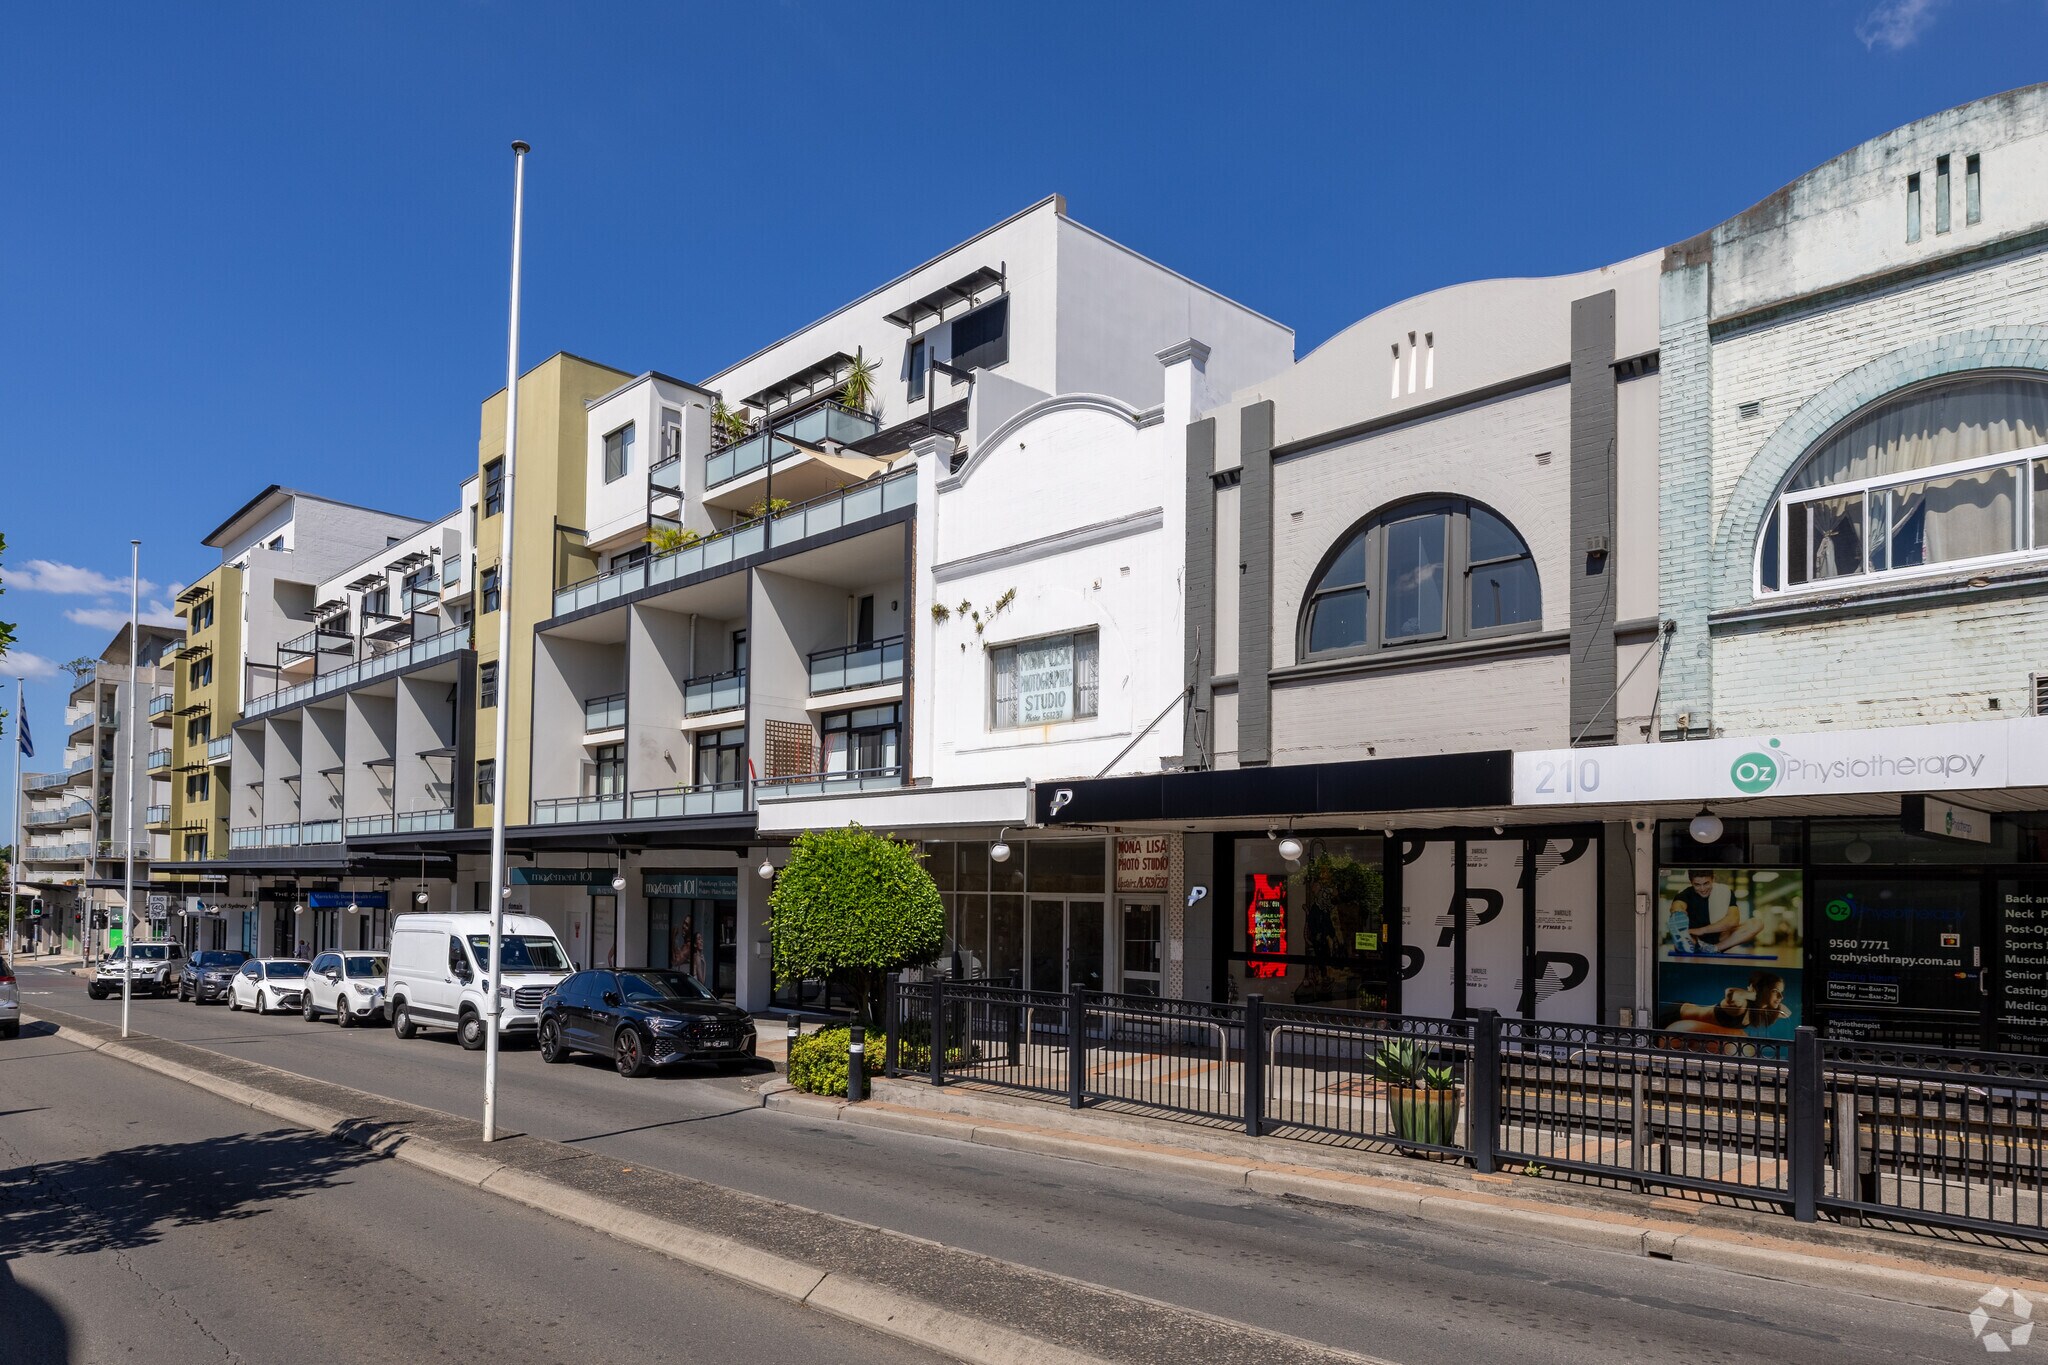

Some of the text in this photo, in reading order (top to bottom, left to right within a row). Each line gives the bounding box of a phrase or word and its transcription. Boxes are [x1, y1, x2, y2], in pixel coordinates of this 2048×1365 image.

[1025, 691, 1066, 711] STUDIO
[1736, 753, 1984, 783] Oz Physiotherapy
[1536, 759, 1600, 793] 210
[1118, 839, 1167, 853] MONA LISA
[1118, 855, 1168, 871] PHOTO STUDIO
[645, 879, 695, 895] movement 101
[2005, 894, 2033, 903] Back
[1828, 904, 1848, 916] Oz
[2005, 909, 2034, 919] Neck
[1829, 938, 1890, 950] 9560 7771
[2005, 939, 2043, 951] Sports
[1829, 952, 1962, 968] ozphysiothrapy.com.au
[2004, 954, 2048, 965] Muscul
[2004, 969, 2043, 980] Senior
[1829, 990, 1856, 999] Saturday
[2004, 985, 2048, 998] Casting
[1828, 1019, 1881, 1030] Physiotherapist
[2005, 1015, 2037, 1026] Third
